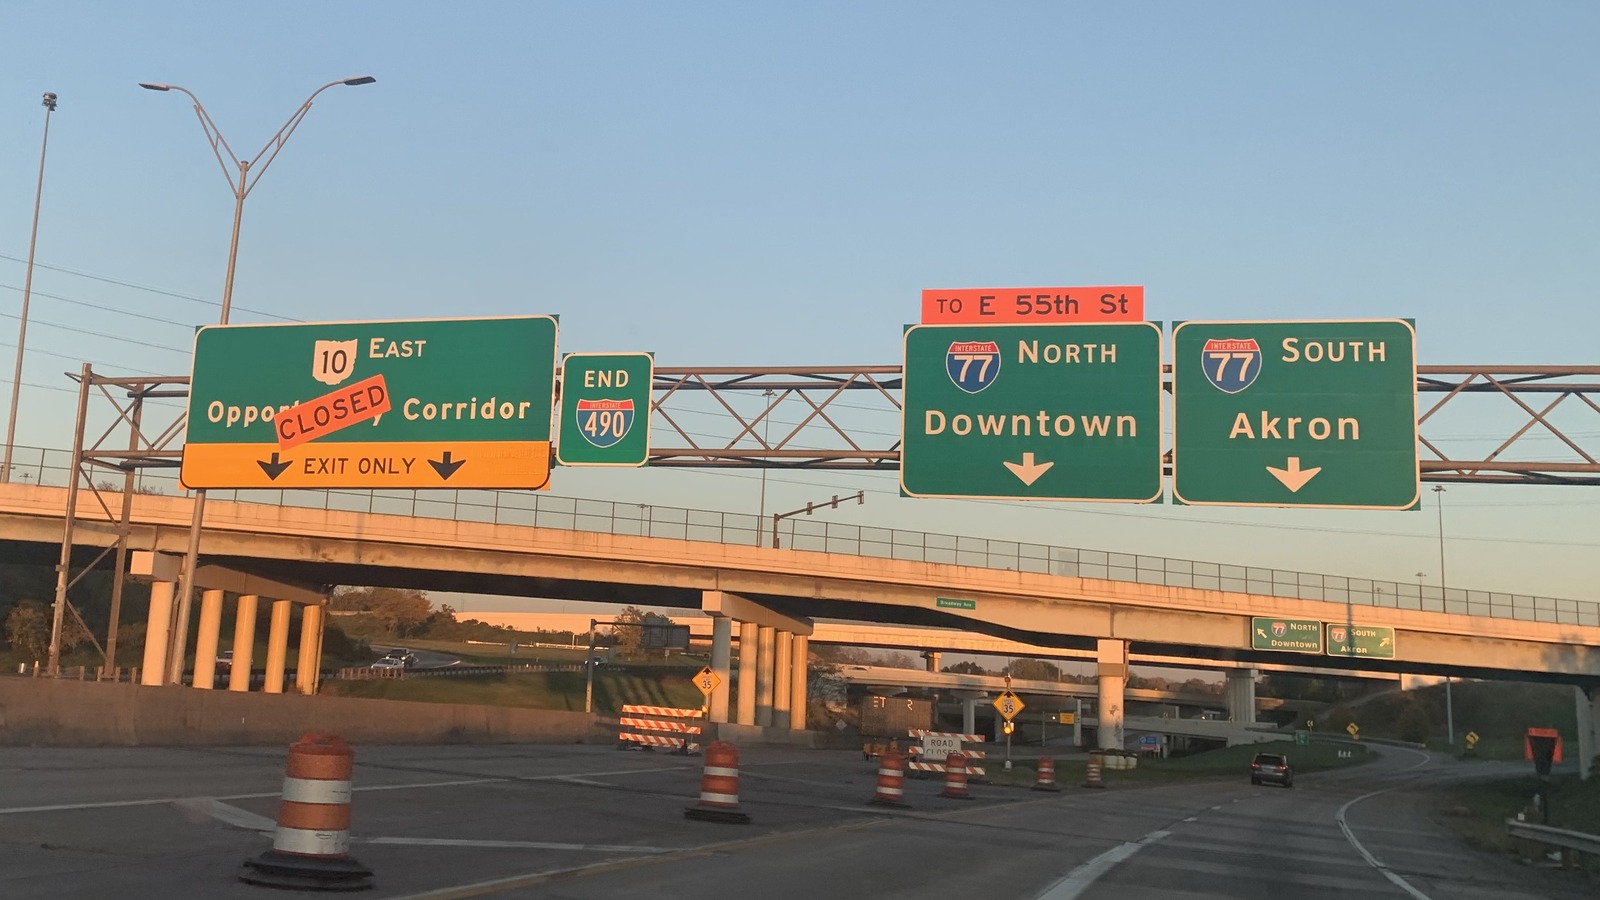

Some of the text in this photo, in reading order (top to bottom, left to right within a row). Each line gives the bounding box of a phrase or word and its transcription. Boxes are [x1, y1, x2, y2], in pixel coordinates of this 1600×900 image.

[936, 293, 1129, 316] TO E 55th St
[369, 337, 427, 358] EAST
[954, 344, 992, 352] INTERSTATE
[1018, 340, 1117, 363] NORTH
[1210, 341, 1252, 350] INTERSTATE
[1281, 337, 1386, 362] SOUTH
[322, 349, 347, 375] 10
[953, 354, 993, 383] 77
[1209, 352, 1254, 382] 77
[584, 369, 629, 388] END
[279, 385, 385, 440] CLOSED
[402, 397, 531, 421] Corridor
[584, 410, 625, 438] 490
[924, 410, 1137, 437] Downtown
[1229, 410, 1360, 440] Akron
[303, 457, 416, 475] EXIT ONLY
[1273, 626, 1285, 634] 77
[1290, 623, 1318, 632] NORTH
[1333, 632, 1345, 640] 77
[1350, 628, 1376, 637] SOUTH
[1271, 639, 1318, 649] Downtown
[1340, 645, 1368, 654] Akron
[702, 680, 712, 689] 35
[1003, 704, 1014, 714] 35
[930, 739, 954, 748] ROAD
